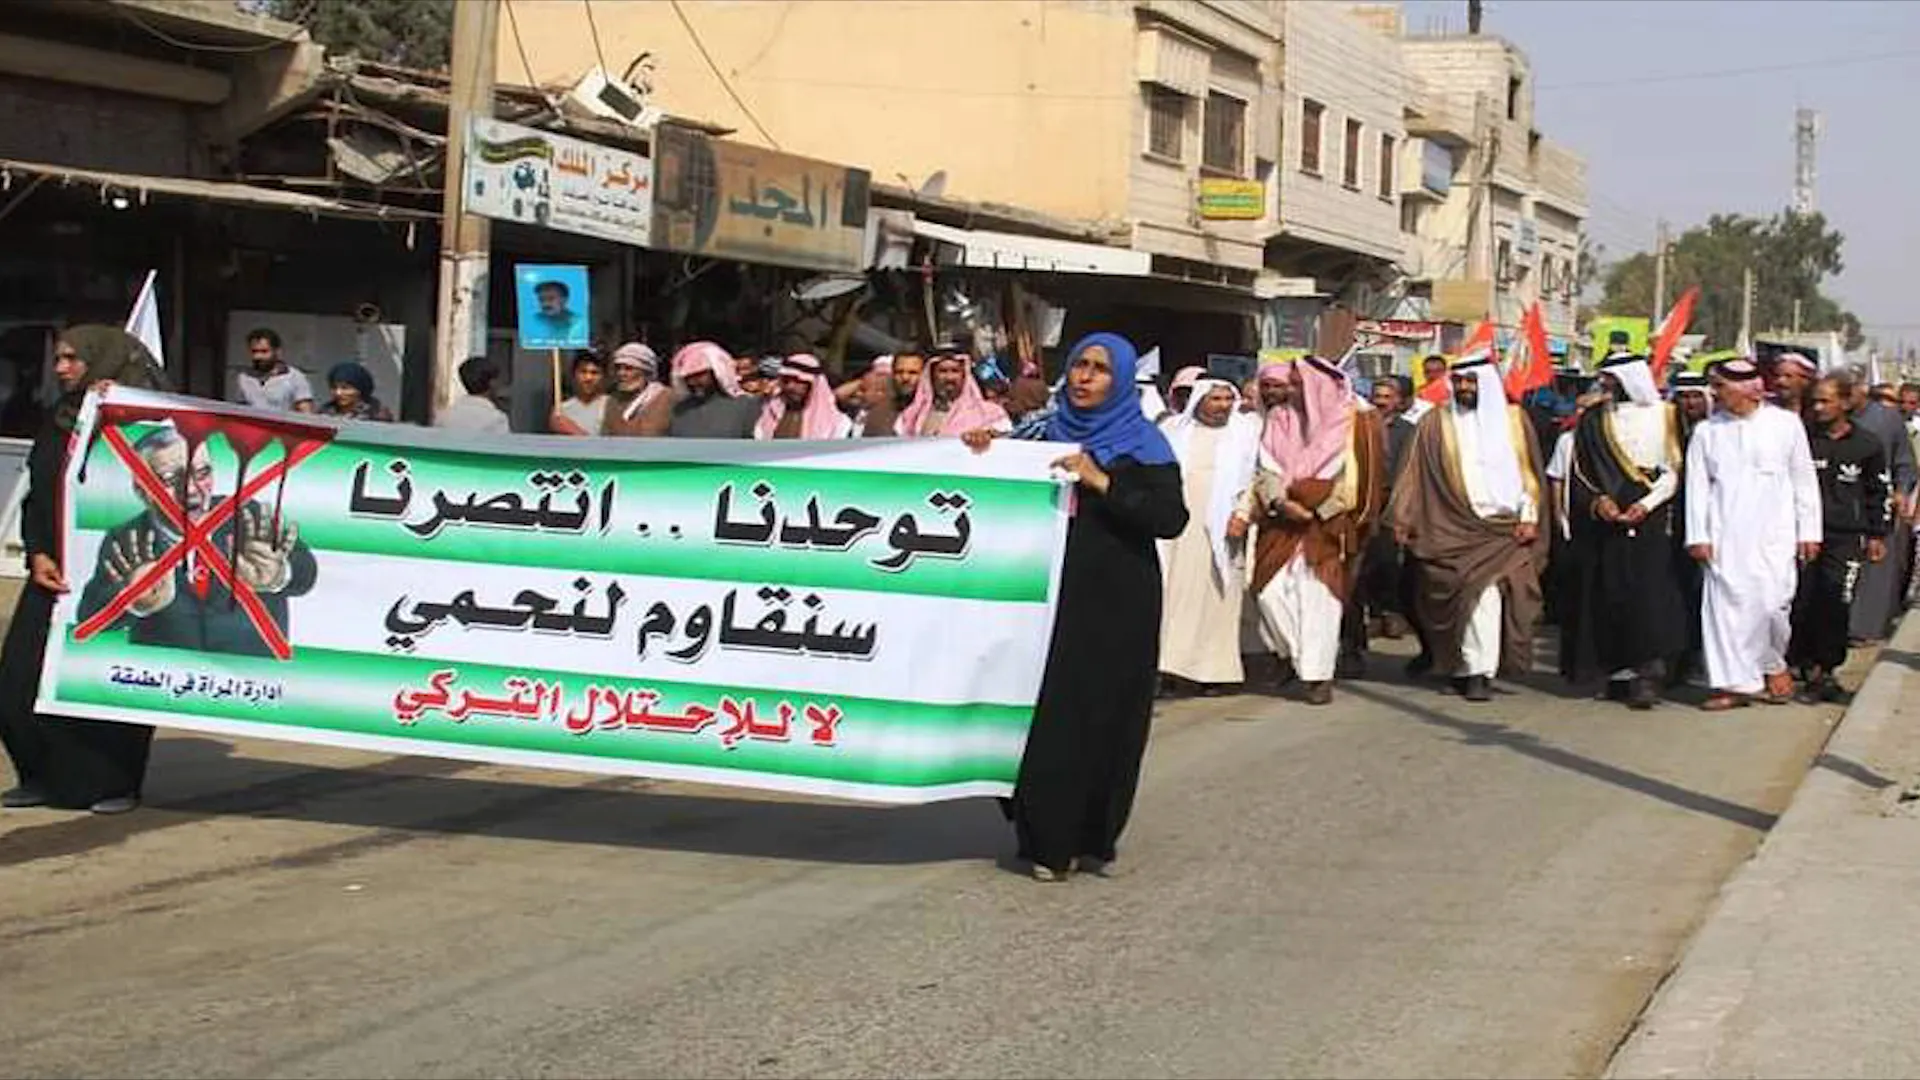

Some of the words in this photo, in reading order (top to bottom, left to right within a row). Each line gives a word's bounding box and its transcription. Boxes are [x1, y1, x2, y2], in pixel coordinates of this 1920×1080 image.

[729, 173, 829, 237] المجد
[349, 460, 616, 537] انتصرنا
[714, 483, 971, 572] توحدنا
[385, 577, 626, 651] لنحمي
[637, 586, 880, 663] سنقاوم
[110, 665, 171, 688] الطبقة
[172, 673, 196, 698] في
[393, 672, 559, 724] التركي
[567, 687, 792, 747] للإحتلال
[805, 702, 843, 744] لا
